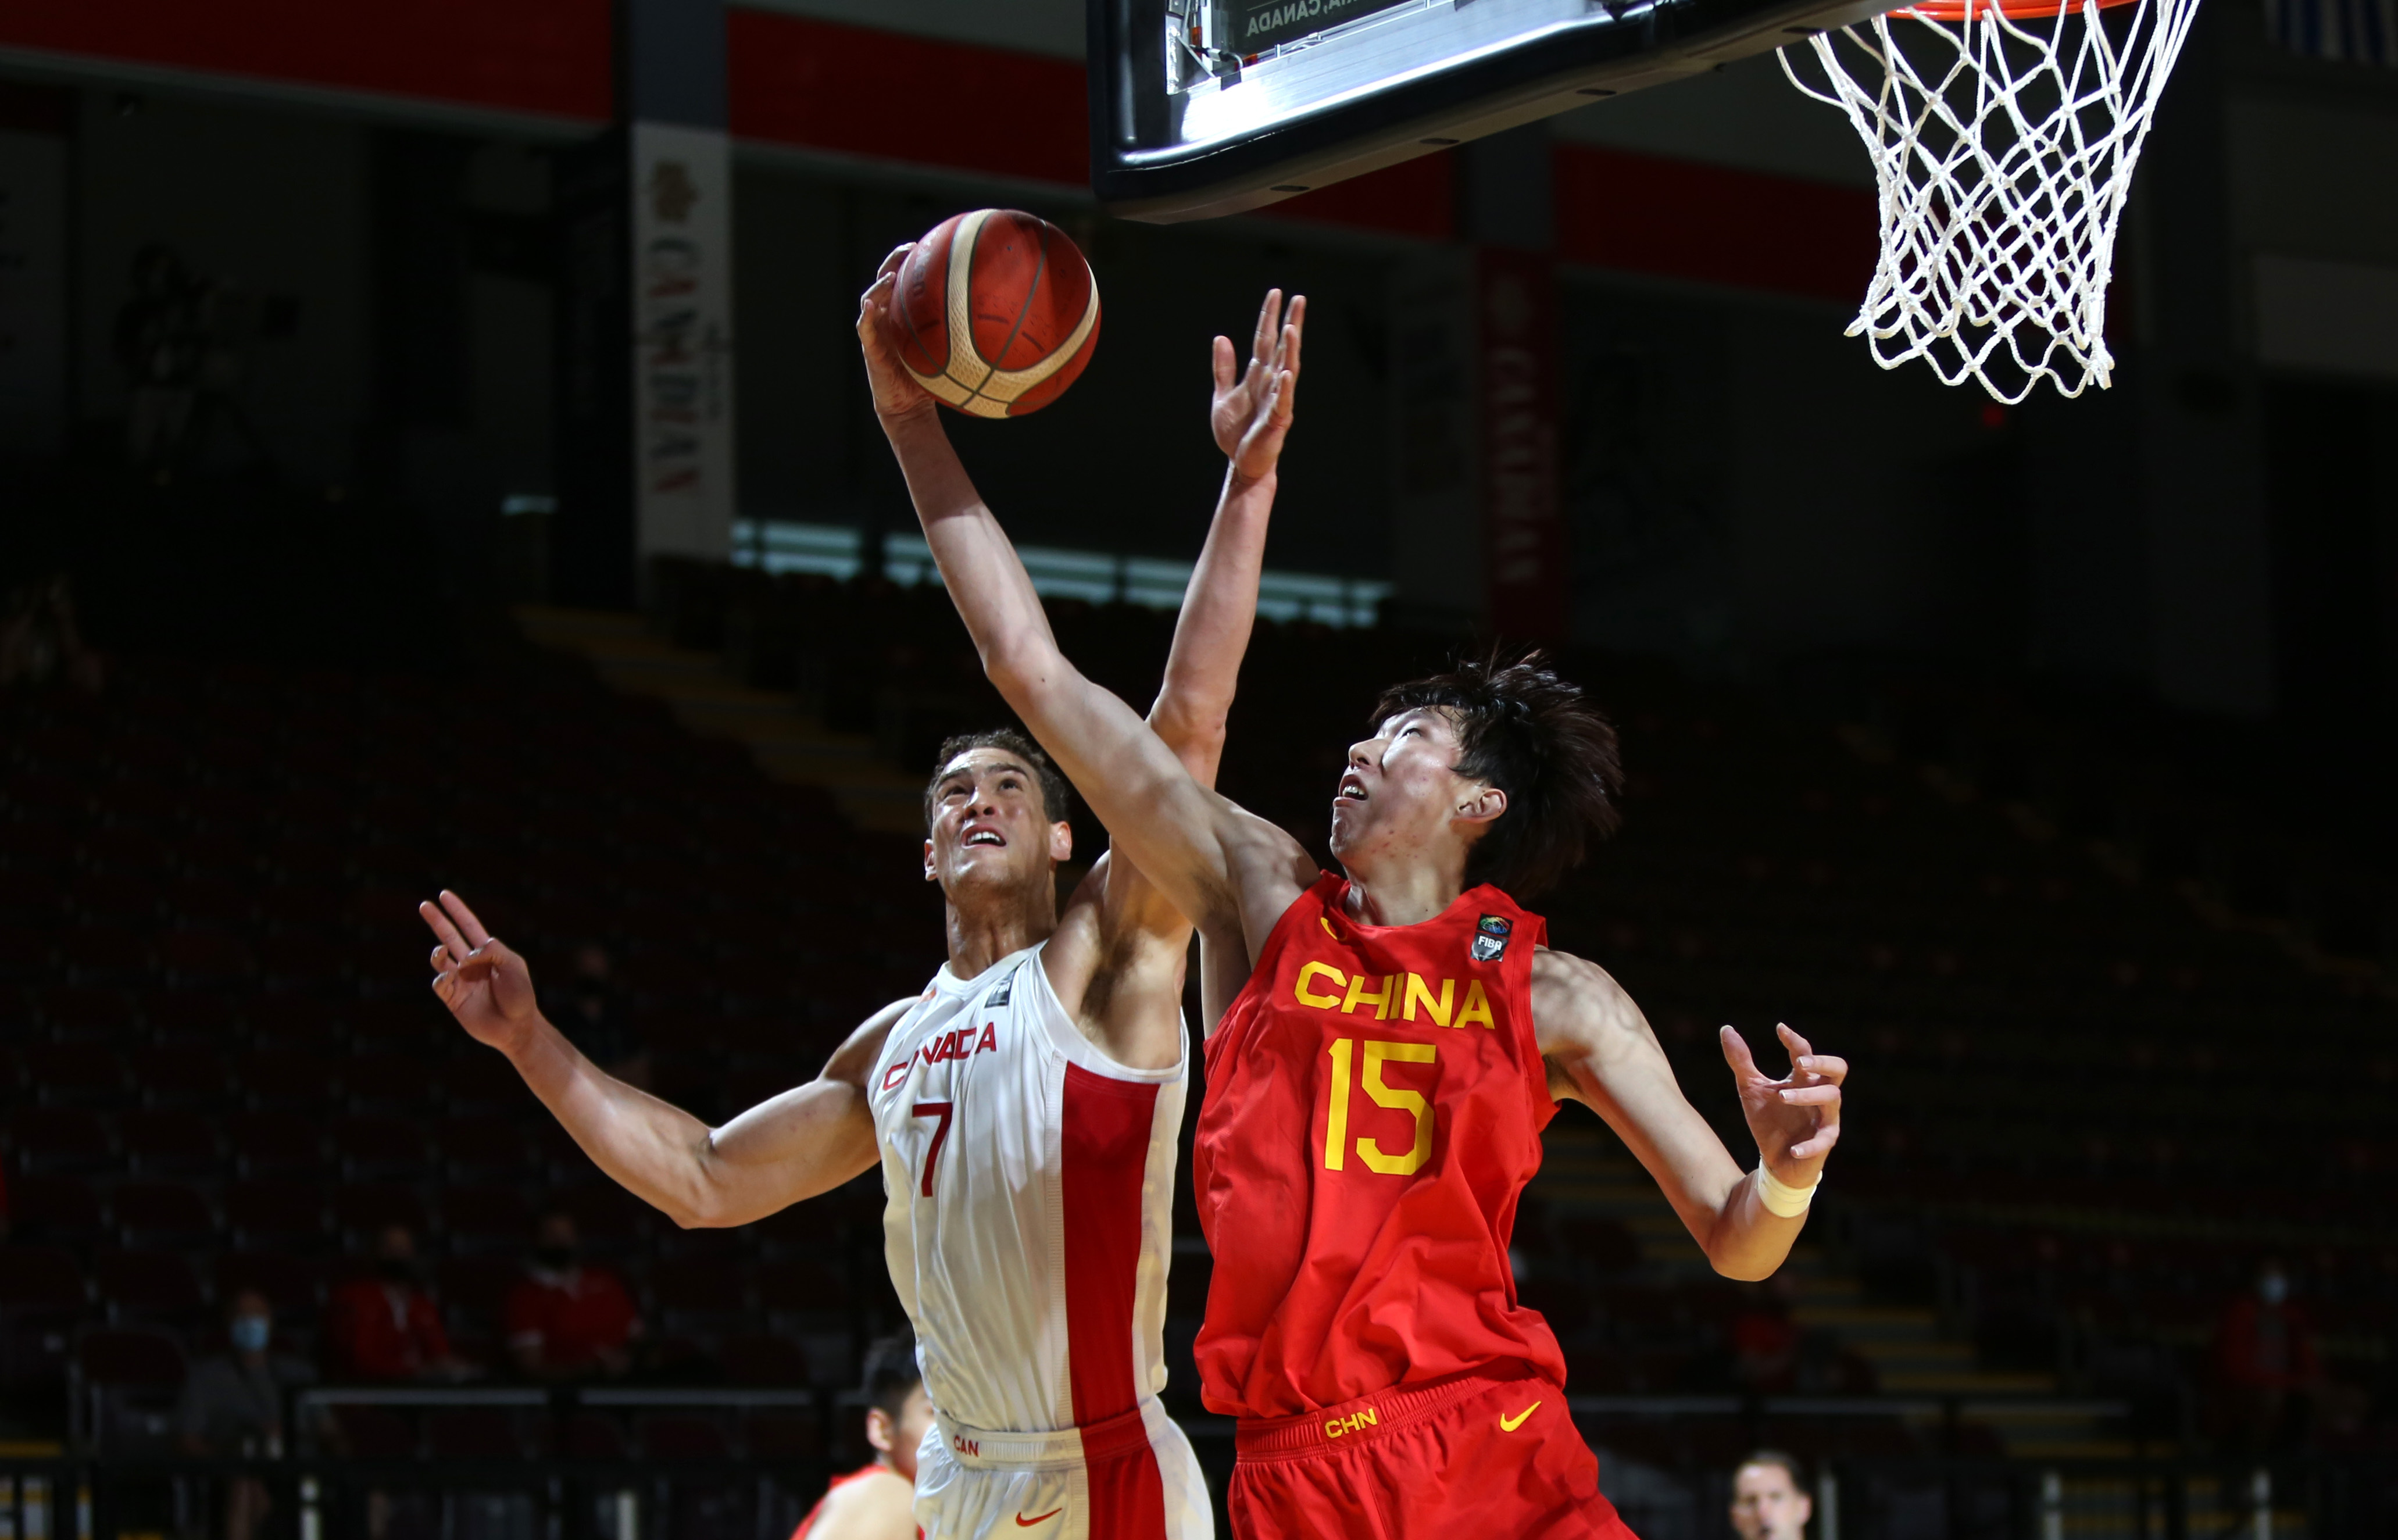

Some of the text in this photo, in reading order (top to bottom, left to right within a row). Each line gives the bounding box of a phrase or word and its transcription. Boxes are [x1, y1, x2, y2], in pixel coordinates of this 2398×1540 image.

[1478, 935, 1502, 951] FIBA
[1294, 960, 1495, 1030] CHINA
[1324, 1038, 1436, 1175] 15
[912, 1102, 952, 1197] 7
[954, 1435, 979, 1457] CAN
[1325, 1408, 1378, 1438] CHN
